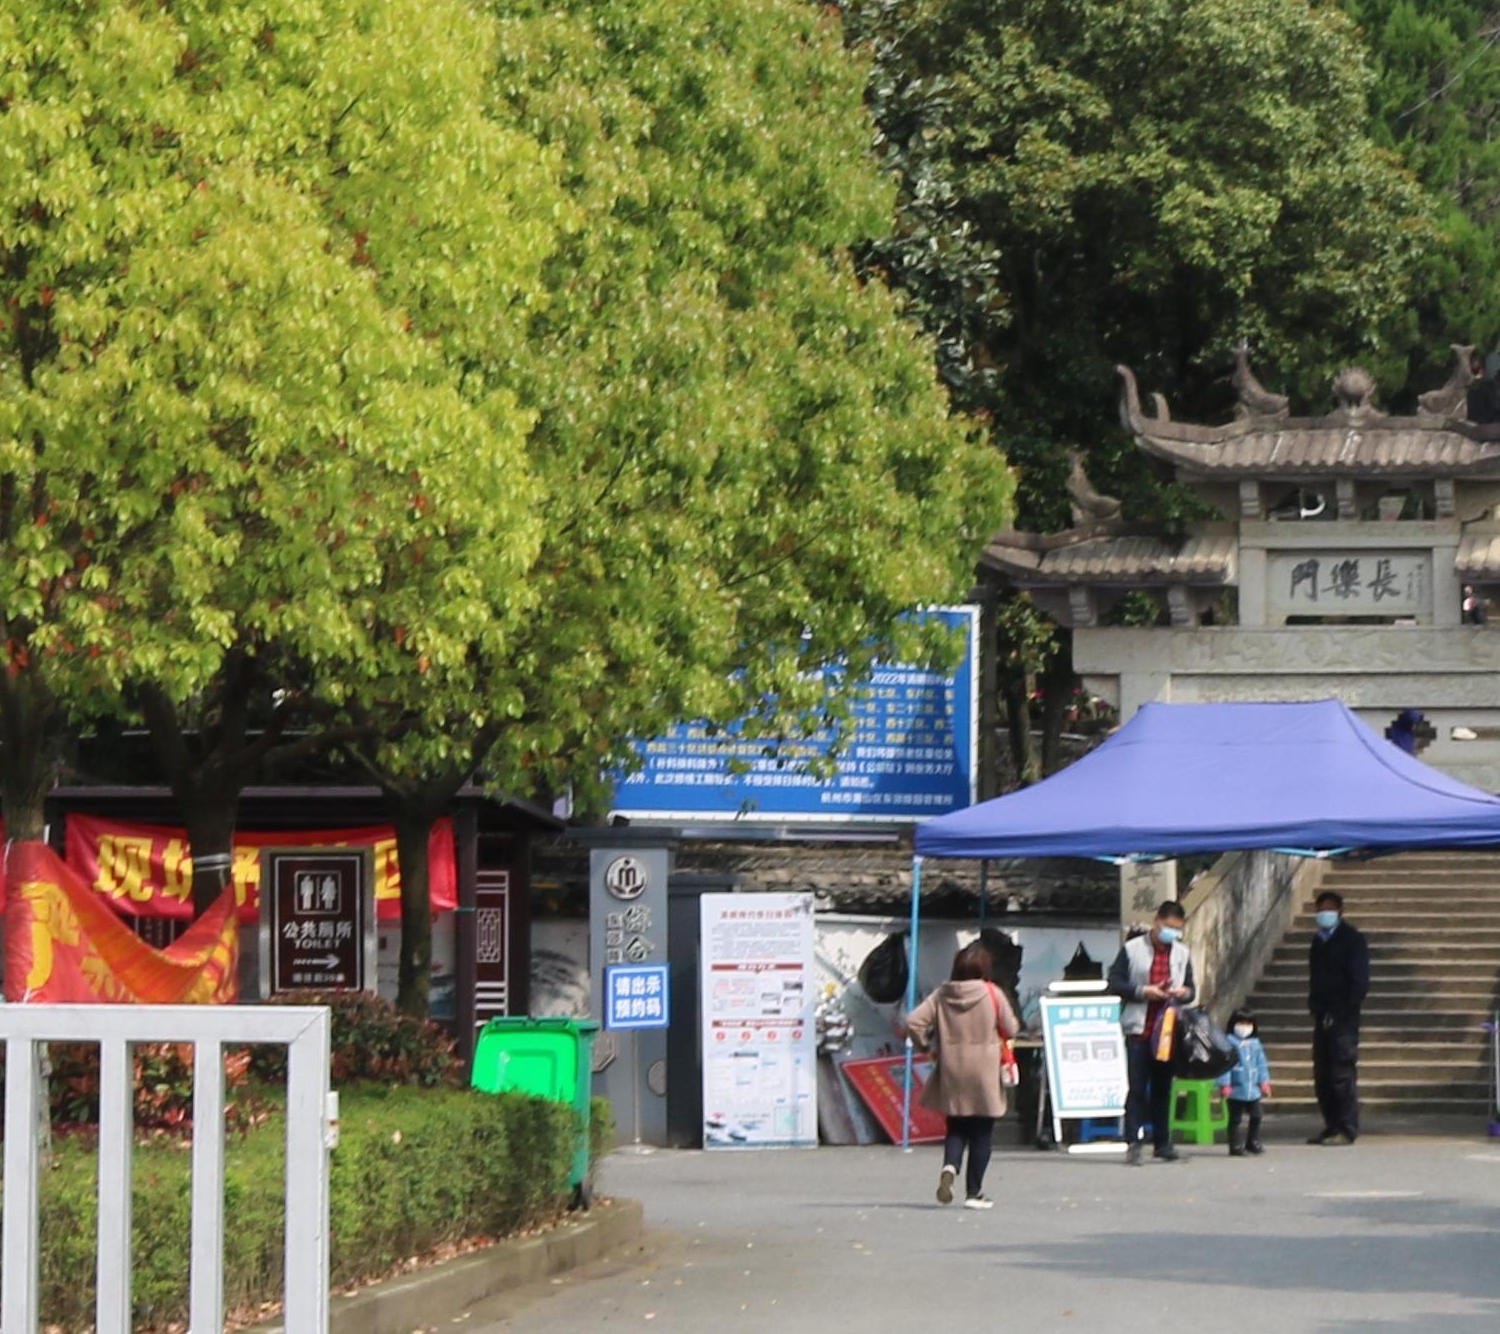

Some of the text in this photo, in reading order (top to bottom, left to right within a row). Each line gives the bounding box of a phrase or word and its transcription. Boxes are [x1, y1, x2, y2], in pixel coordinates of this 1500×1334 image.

[282, 920, 353, 939] 公共厕所
[293, 938, 341, 949] TOILET
[615, 974, 661, 997] 请出示
[615, 997, 661, 1020] 预约码
